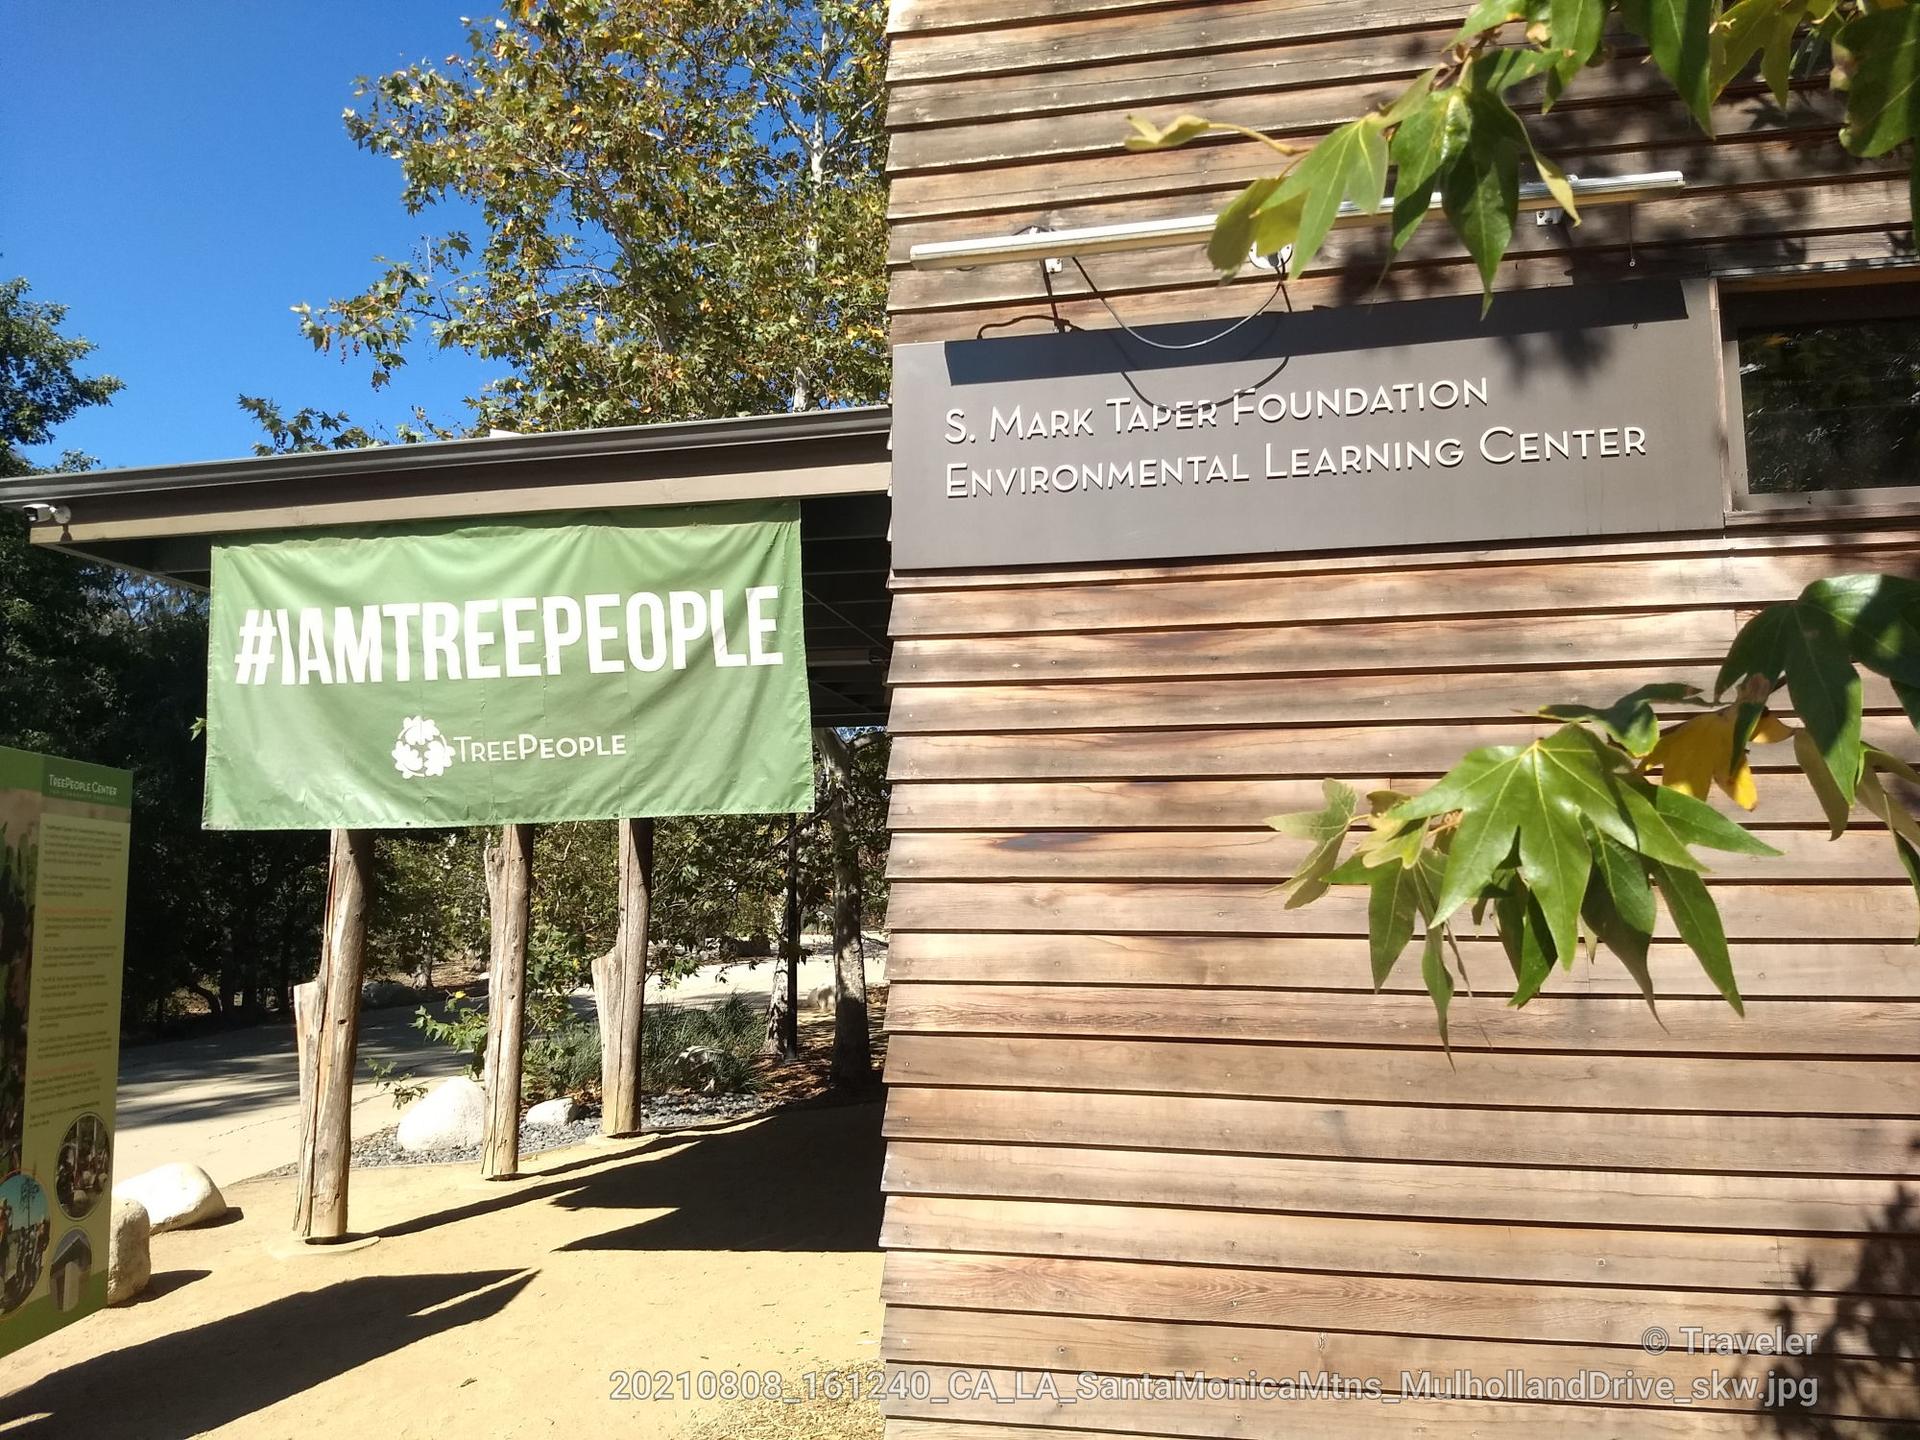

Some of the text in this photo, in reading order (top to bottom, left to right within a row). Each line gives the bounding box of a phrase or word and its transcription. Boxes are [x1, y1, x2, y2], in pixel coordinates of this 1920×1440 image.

[944, 376, 1490, 445] S. MARK TAPER FOUNDATION
[946, 424, 1648, 498] ENVIRONMENTAL LEARNING CENTER
[234, 585, 784, 685] #IAMTREEPEOPLE
[453, 733, 627, 763] TREEPEOPLE
[49, 774, 92, 792] TREEPEOPLE
[91, 781, 118, 796] CENTER
